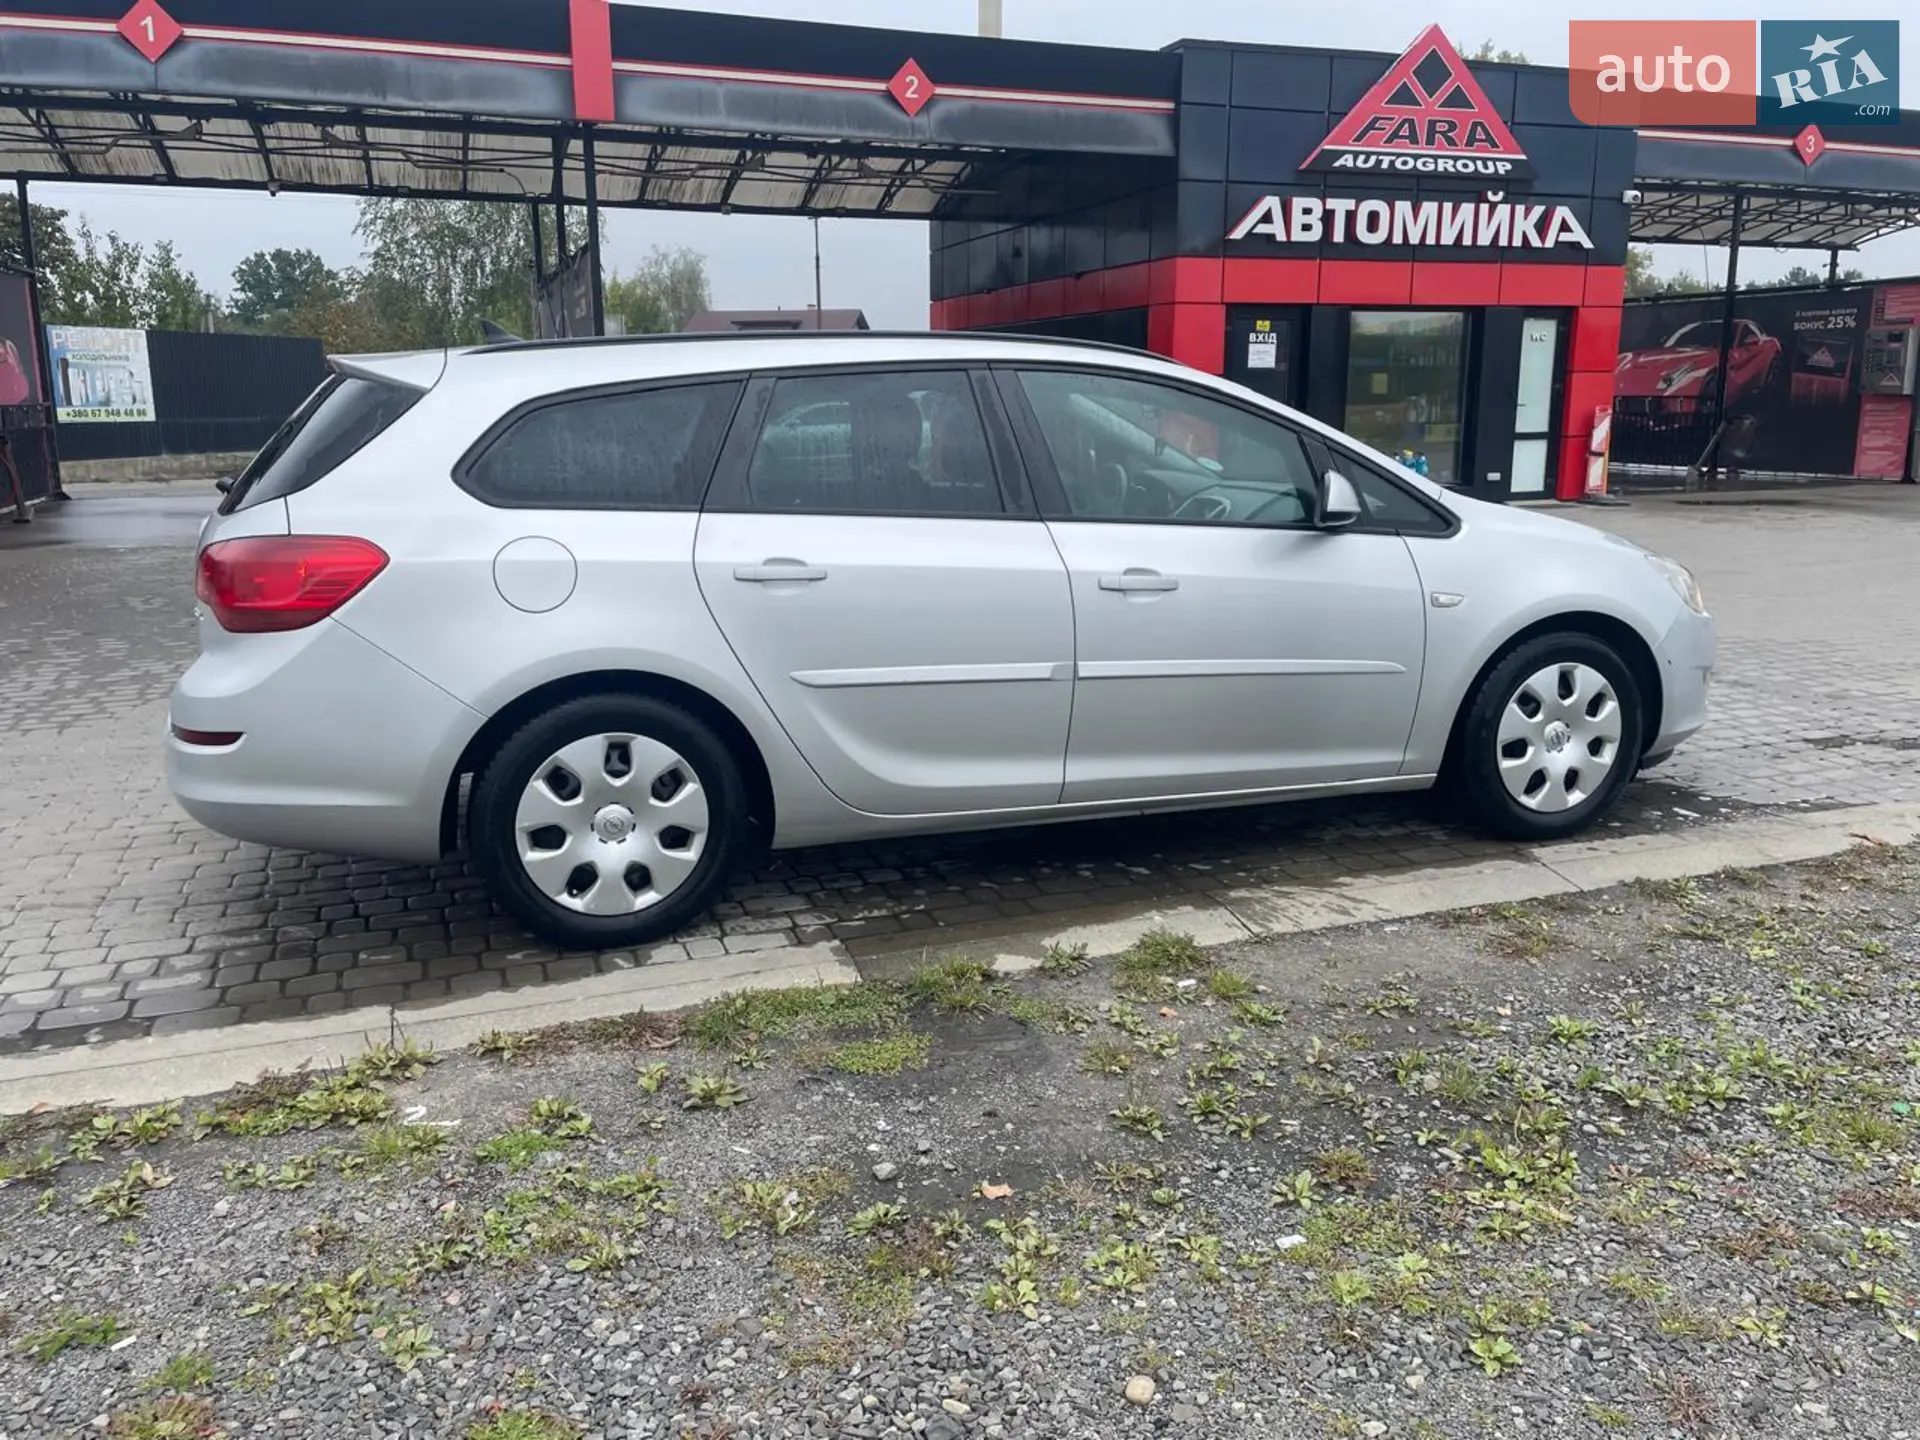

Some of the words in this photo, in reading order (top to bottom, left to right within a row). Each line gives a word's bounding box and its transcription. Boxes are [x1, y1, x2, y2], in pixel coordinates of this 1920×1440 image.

[139, 15, 155, 42] 1
[905, 75, 919, 98] 2
[1349, 115, 1504, 151] FARA
[1805, 134, 1816, 153] 3
[1332, 153, 1513, 175] AUTOGROUP
[1226, 190, 1594, 250] АВТОМИЙКА
[1794, 320, 1825, 330] БОНУС
[1827, 315, 1857, 329] 25%
[52, 329, 143, 352] РЕМОНТ
[1249, 332, 1277, 344] ВХІД
